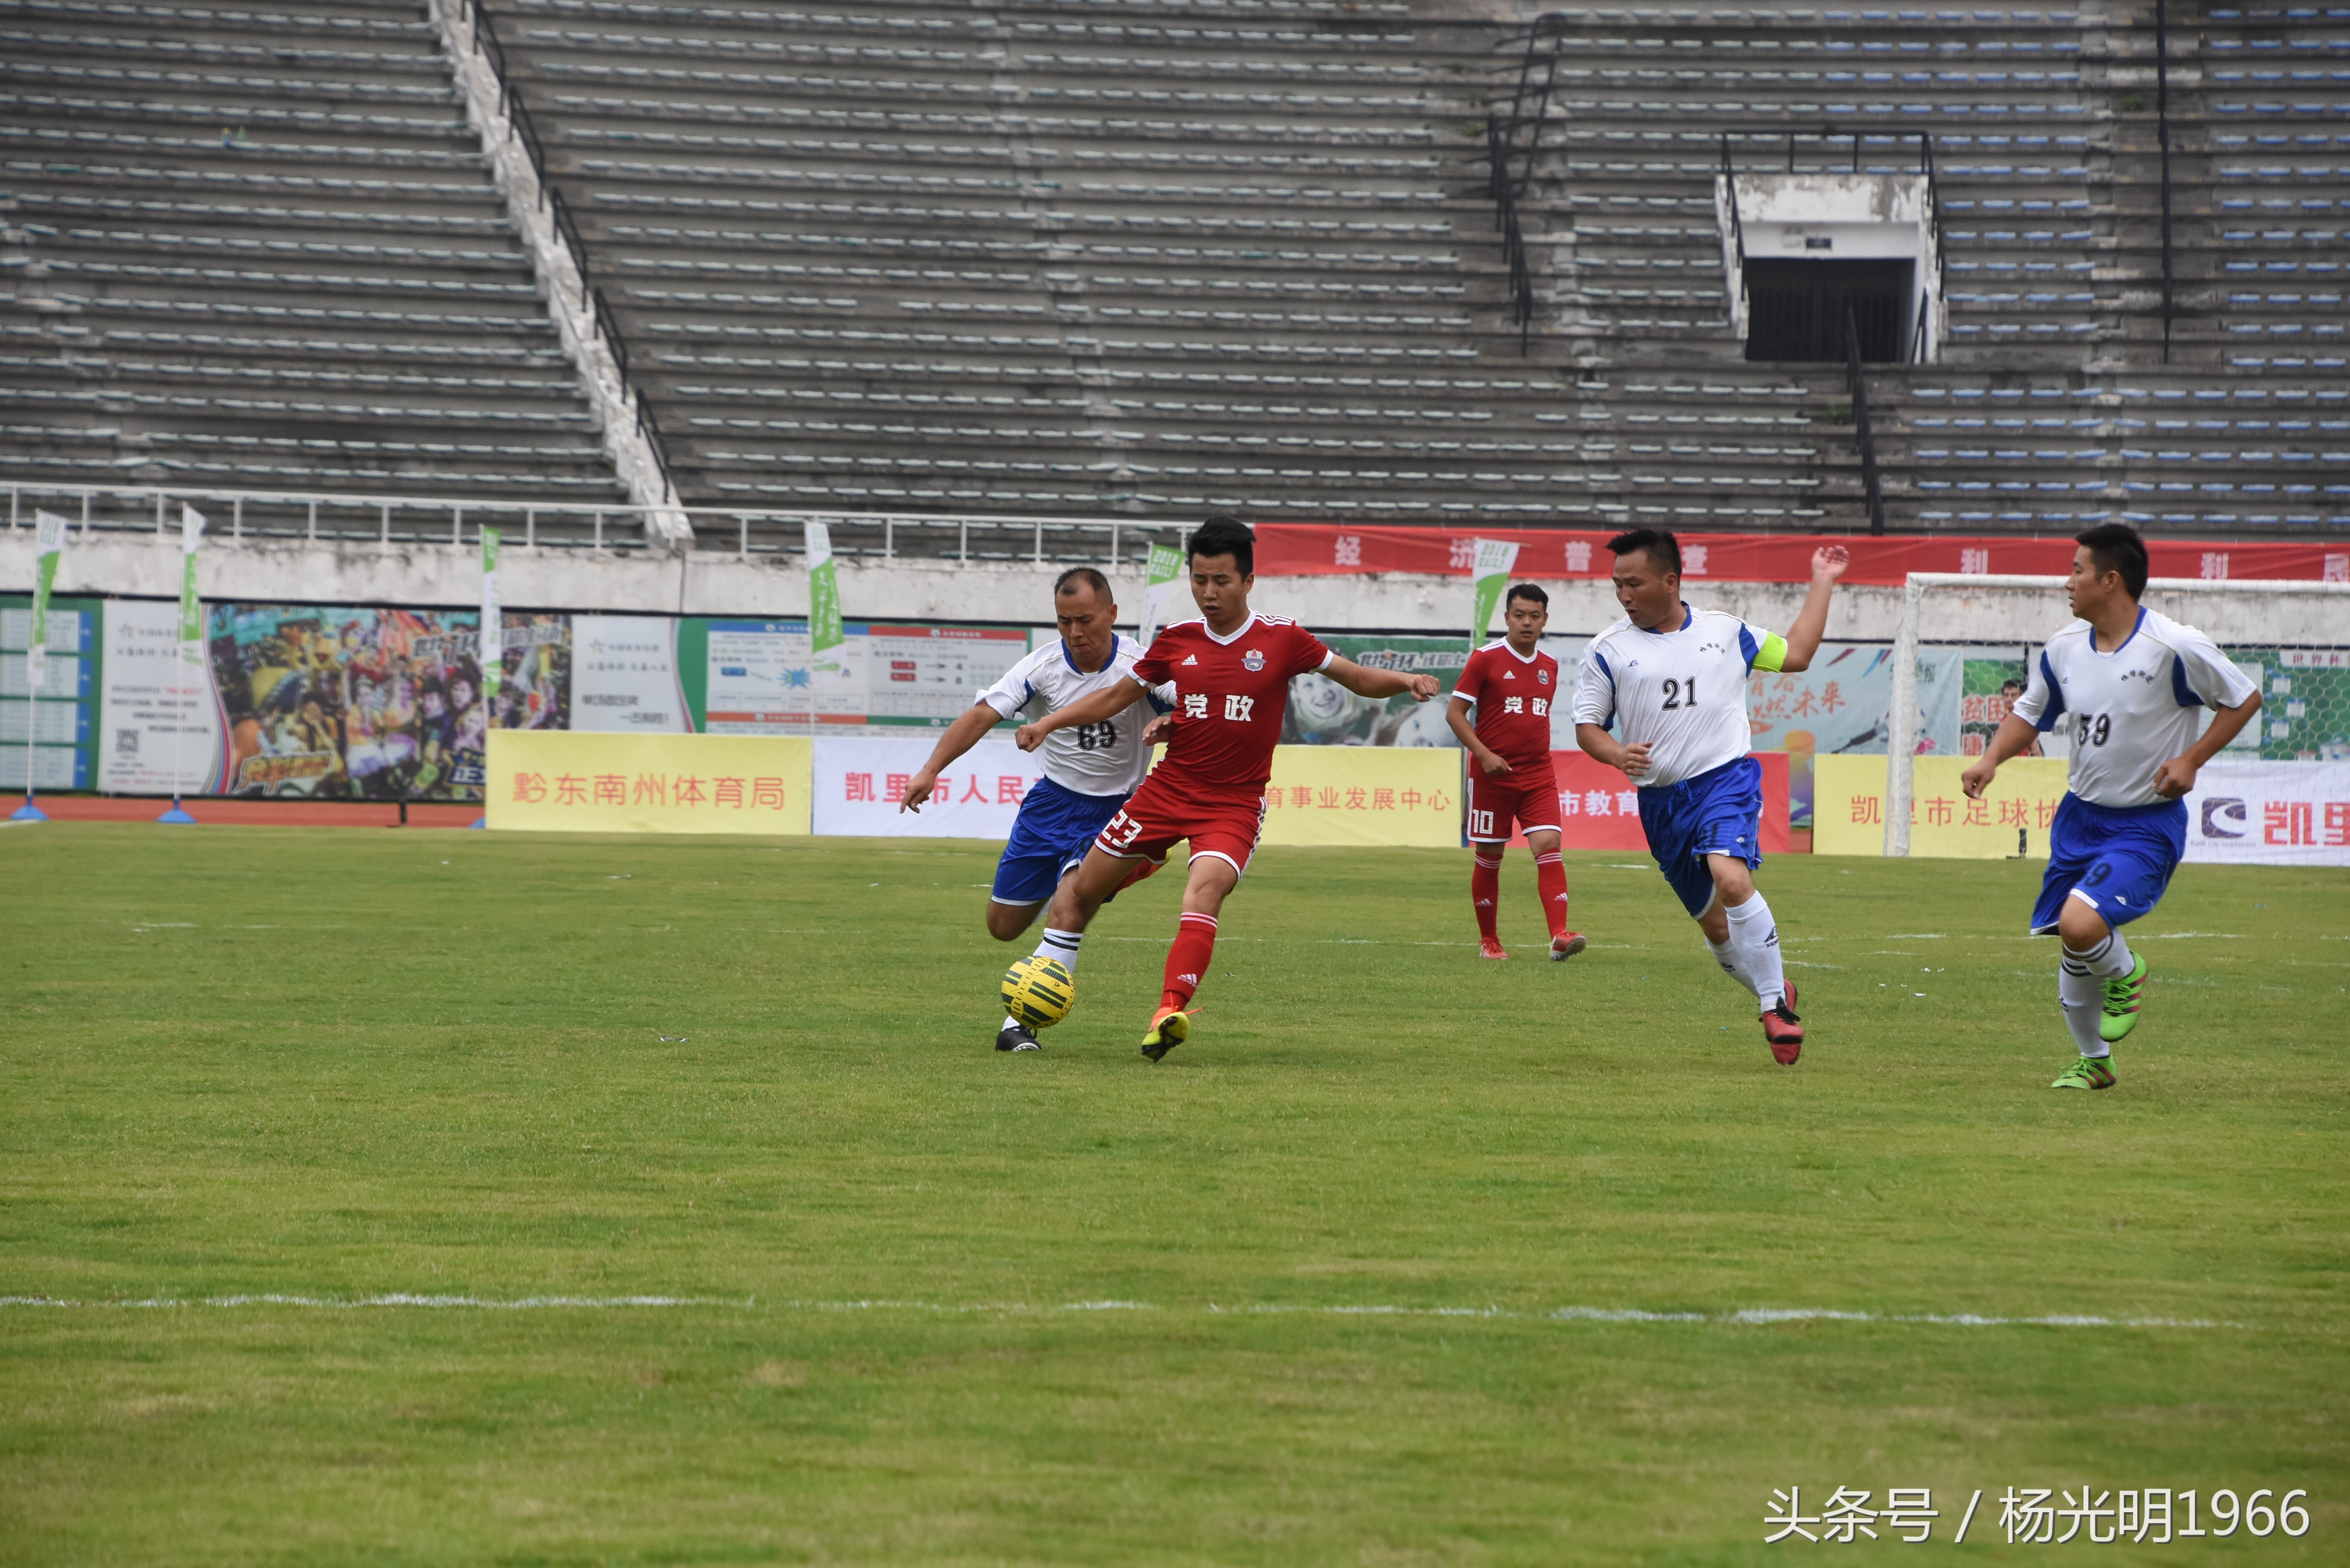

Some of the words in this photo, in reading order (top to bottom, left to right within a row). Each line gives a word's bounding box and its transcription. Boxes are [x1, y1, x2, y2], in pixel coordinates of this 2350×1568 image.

[1184, 694, 1254, 722] 党政
[1504, 696, 1548, 717] 党政
[1662, 676, 1697, 711] 21
[1077, 720, 1117, 752] 69
[512, 772, 785, 810] 黔东南州体育局
[846, 772, 1044, 805] 凯里市人民
[1102, 810, 1143, 849] 23
[1472, 809, 1494, 834] 10
